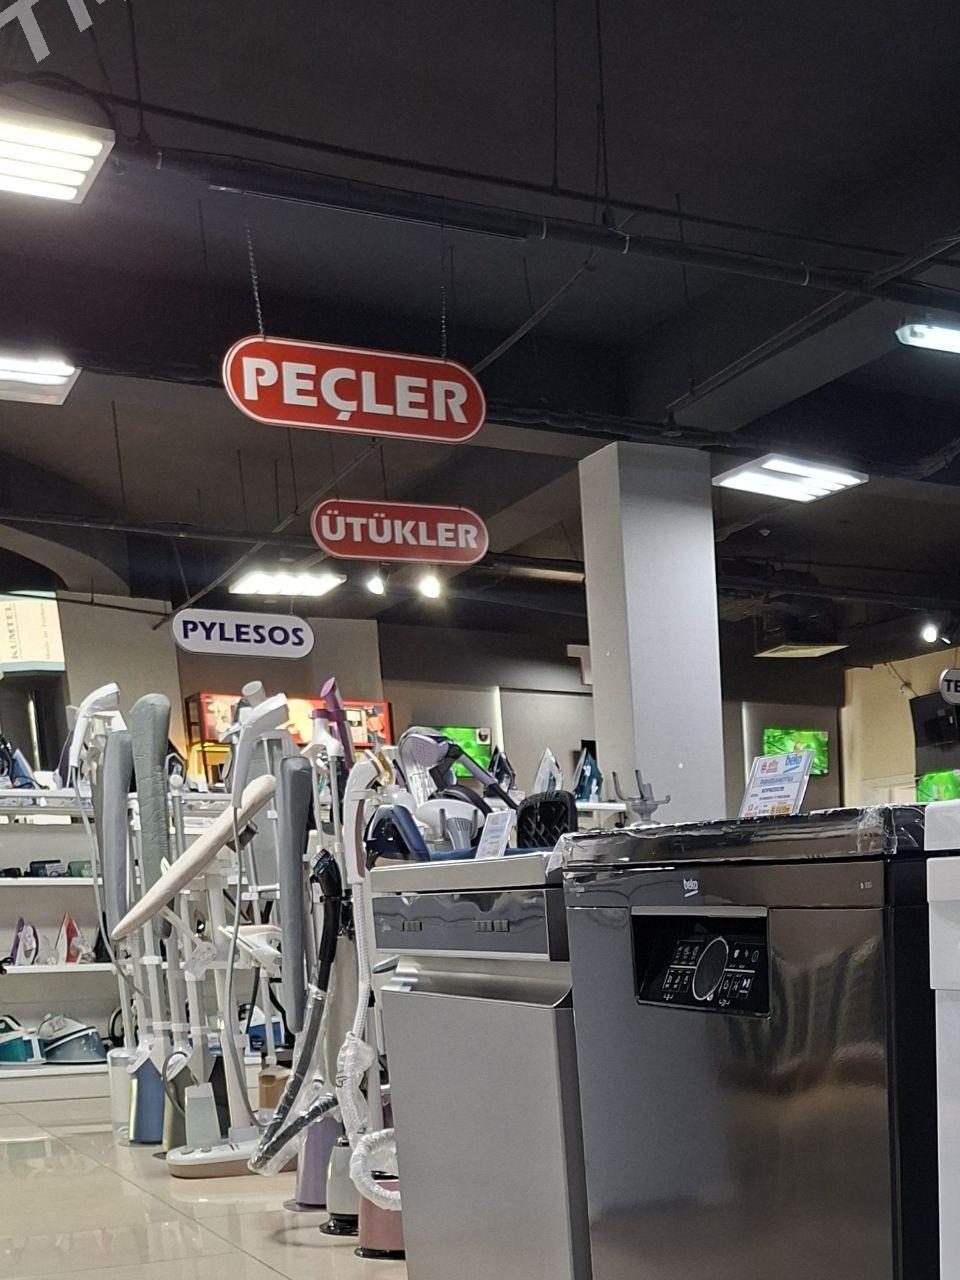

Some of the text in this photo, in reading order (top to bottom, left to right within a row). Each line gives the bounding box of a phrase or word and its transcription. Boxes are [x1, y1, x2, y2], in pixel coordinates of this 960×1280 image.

[242, 356, 468, 424] PEÇLER
[321, 509, 479, 549] ÜTÜKLER
[182, 619, 305, 647] PYLESOS
[683, 877, 699, 890] beko
